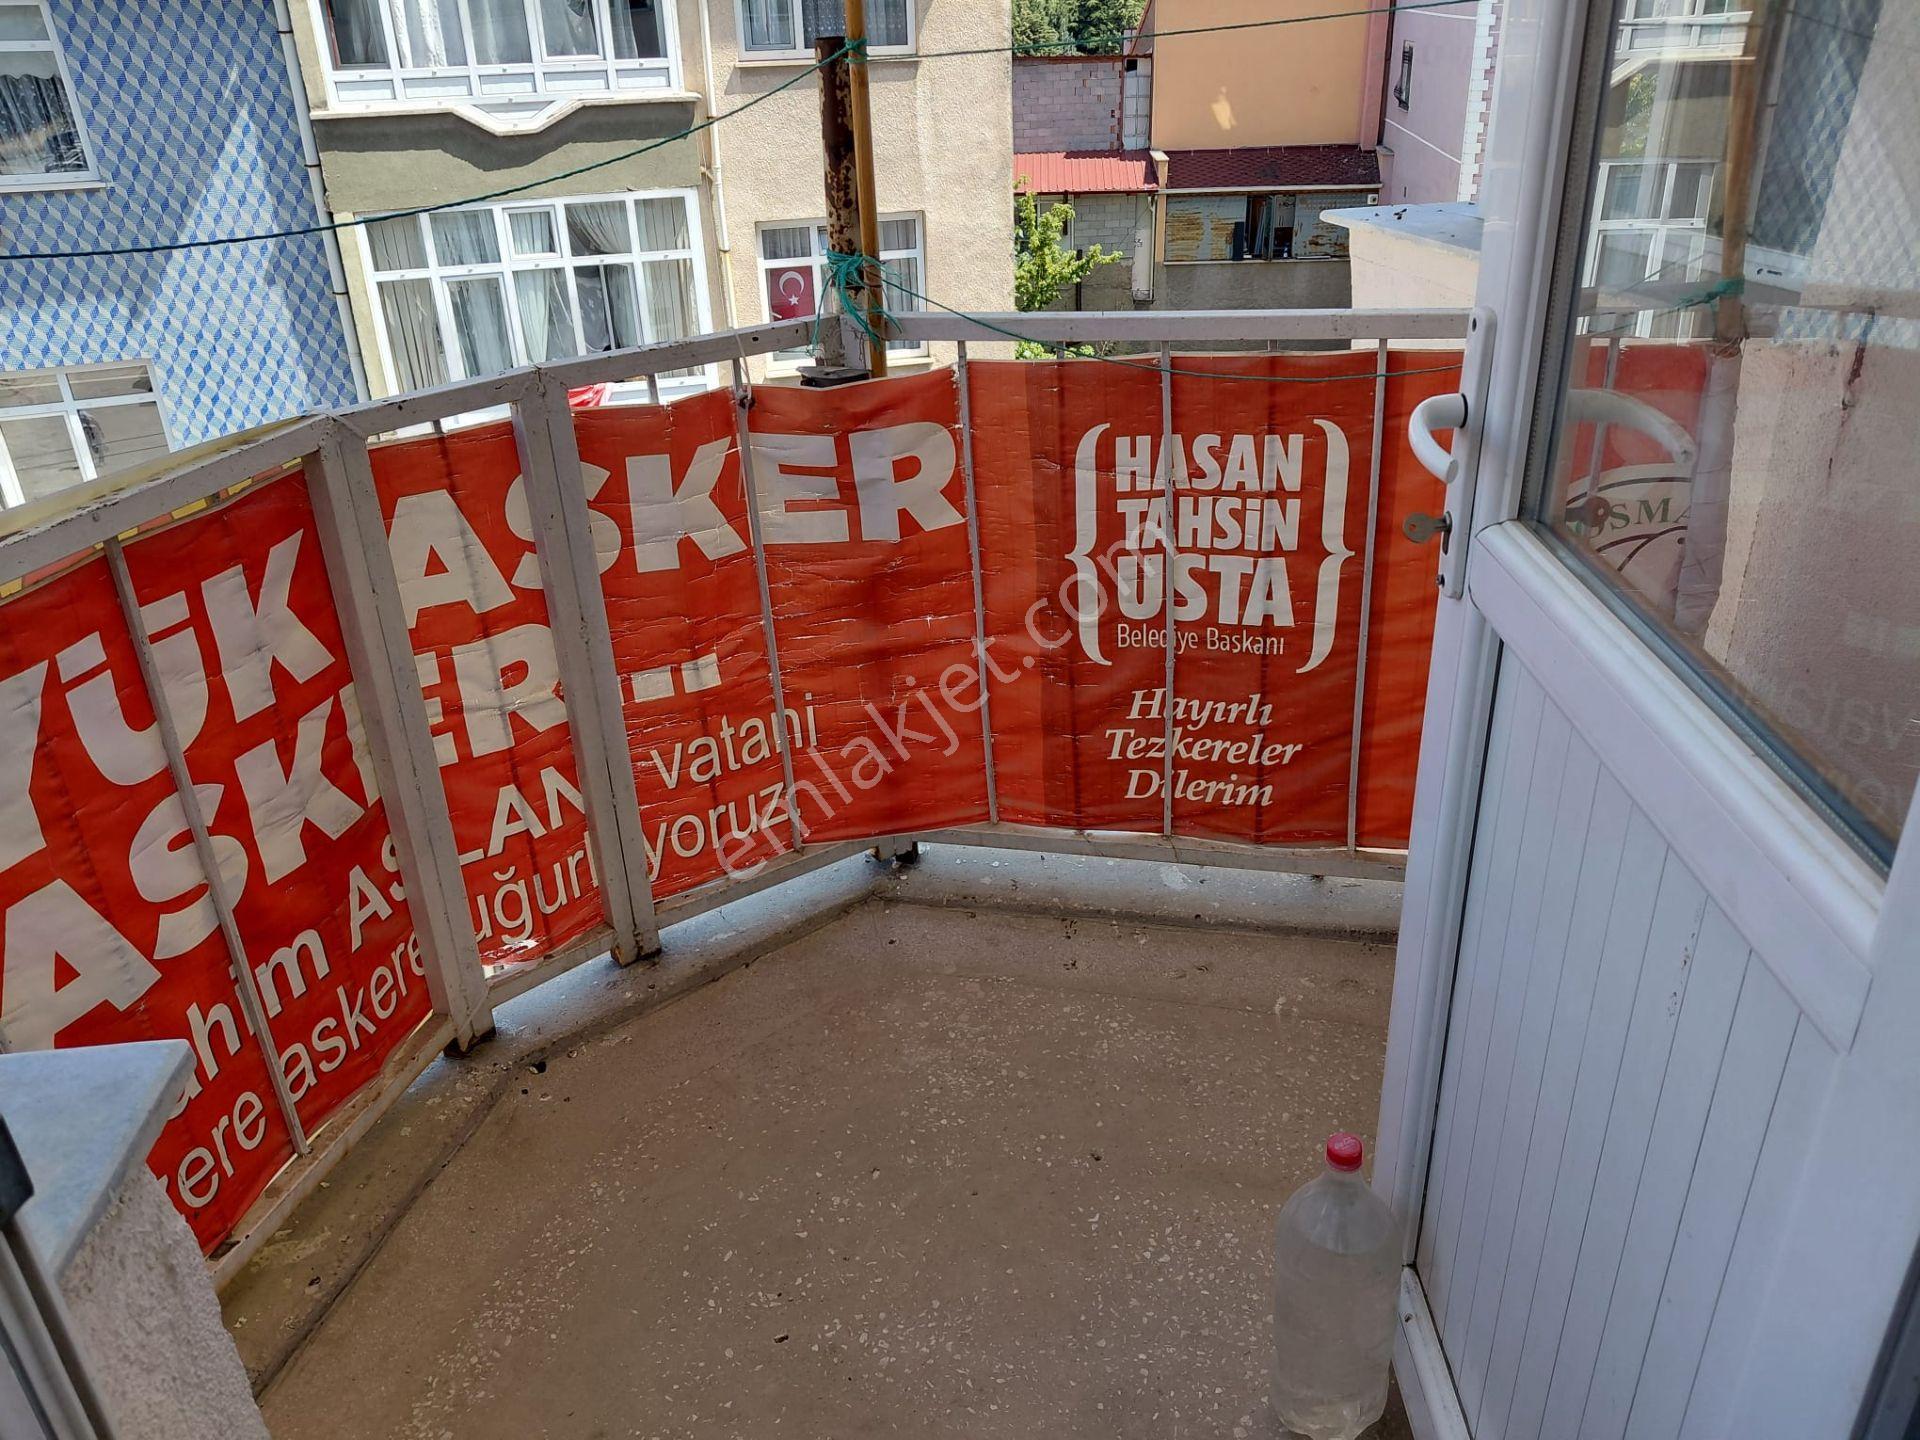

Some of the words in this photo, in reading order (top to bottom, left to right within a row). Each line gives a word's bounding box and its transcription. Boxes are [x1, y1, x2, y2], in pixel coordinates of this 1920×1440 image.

[1115, 434, 1304, 492] HASAN
[388, 421, 966, 629] ASKER
[1117, 553, 1295, 627] USTA
[650, 692, 818, 790] vatani
[1105, 727, 1303, 766] Tezkereler
[1126, 688, 1274, 731] Hayırlı
[157, 1091, 267, 1208] ere
